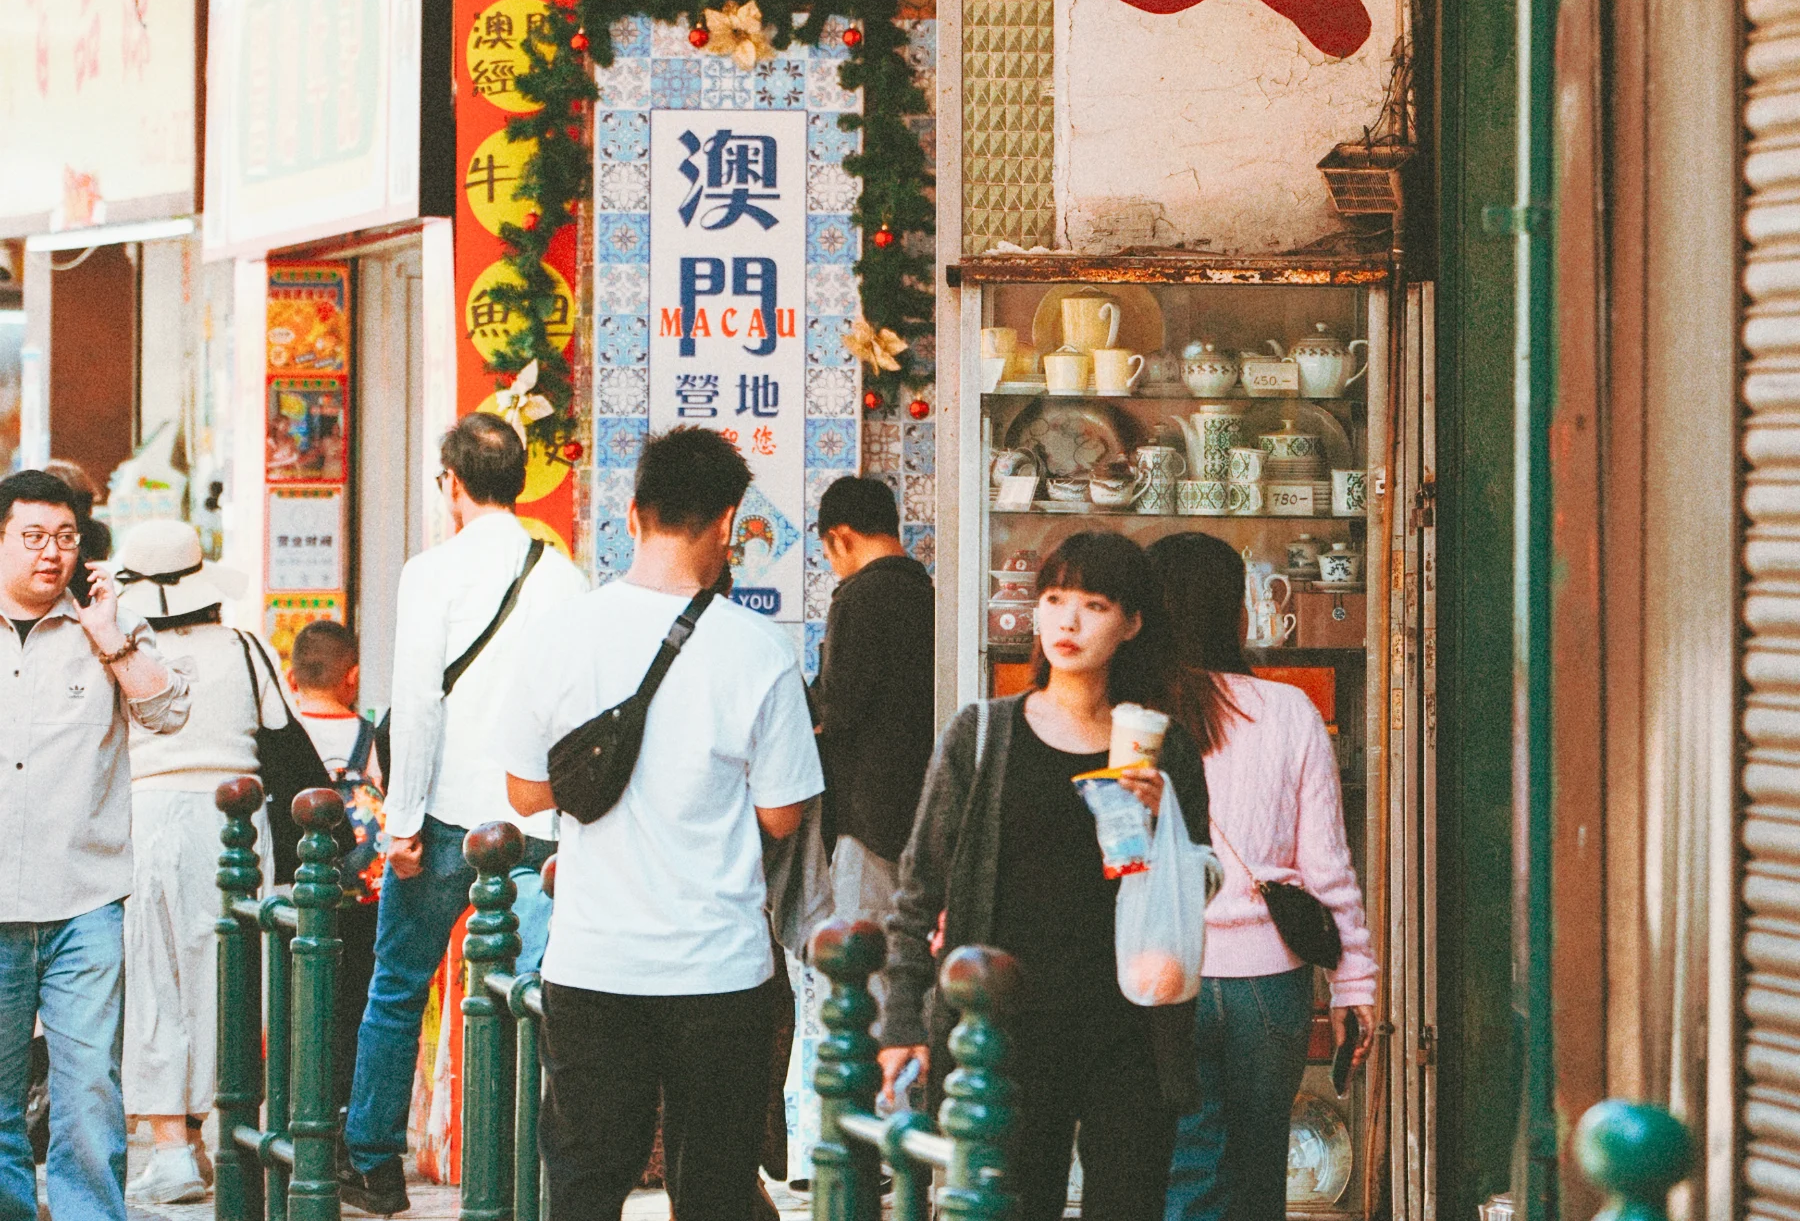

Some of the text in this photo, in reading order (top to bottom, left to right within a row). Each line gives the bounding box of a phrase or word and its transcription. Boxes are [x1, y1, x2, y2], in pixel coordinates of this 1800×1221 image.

[677, 129, 781, 358] 澳門
[659, 307, 797, 339] MACAU
[676, 374, 780, 419] 營地
[739, 595, 775, 610] YOU
